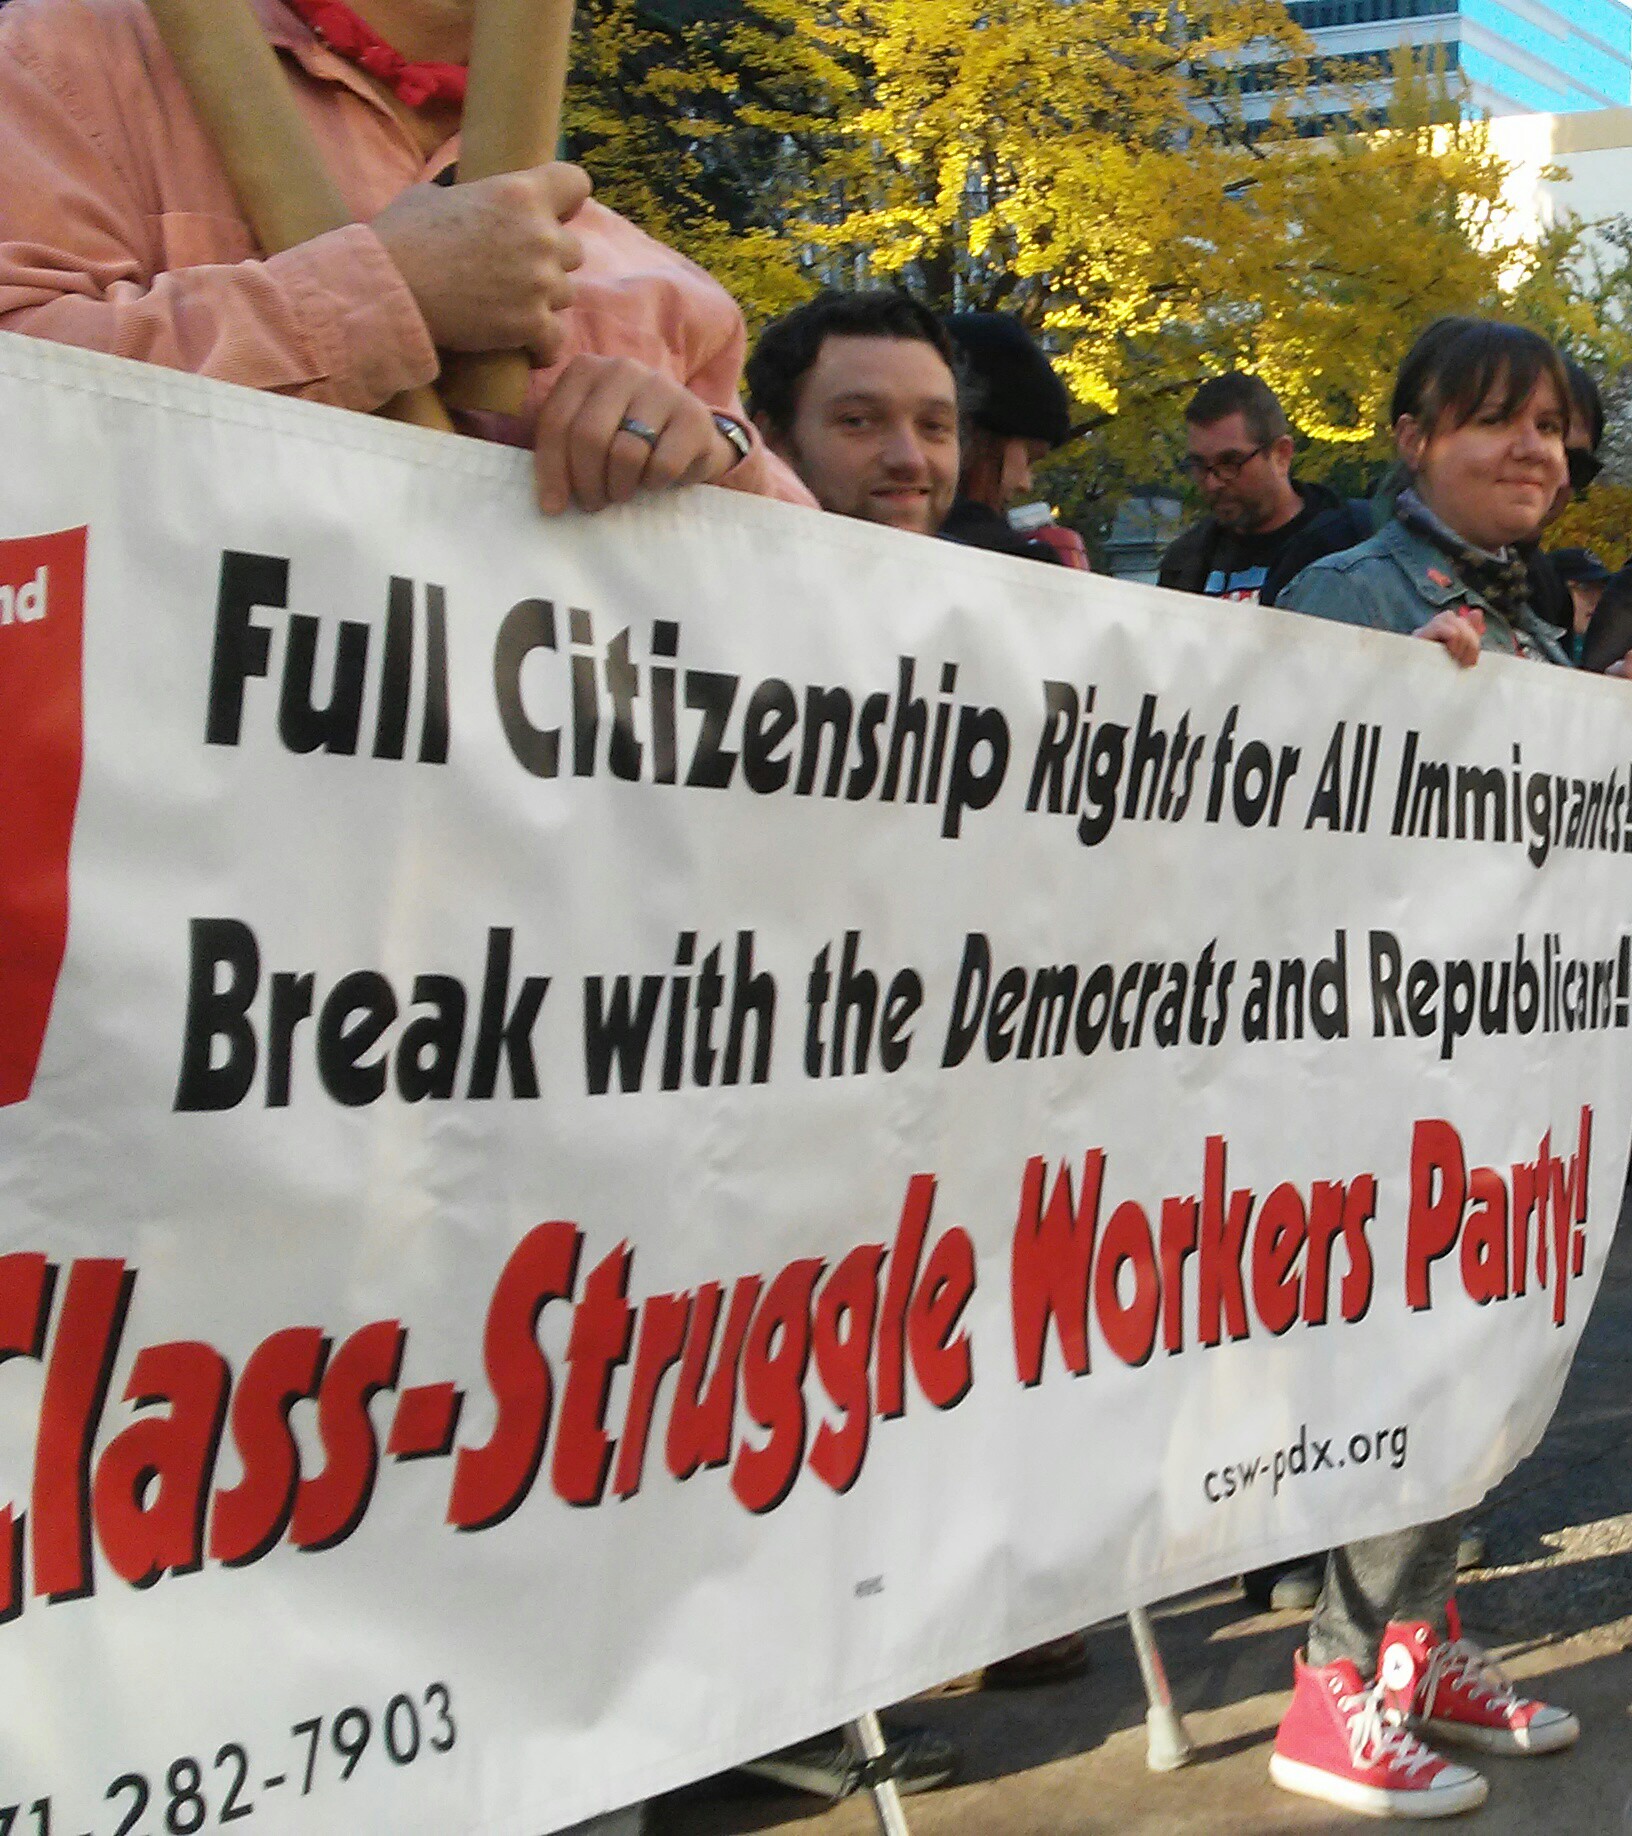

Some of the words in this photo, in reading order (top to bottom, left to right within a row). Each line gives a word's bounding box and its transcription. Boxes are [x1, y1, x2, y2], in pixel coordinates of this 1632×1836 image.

[204, 548, 449, 765] Full
[491, 598, 1010, 840] Citizenship
[1026, 679, 1203, 846] Rights
[1205, 705, 1303, 829] for
[1306, 721, 1381, 834] All
[173, 917, 552, 1113] Break
[584, 929, 777, 1097] with
[805, 930, 922, 1073] the
[941, 931, 1235, 1068] Democrats
[1243, 929, 1349, 1042] and
[1011, 1135, 1378, 1389] Workers
[1404, 1104, 1592, 1327] Party!
[1202, 1424, 1410, 1504] csw-pdx.org
